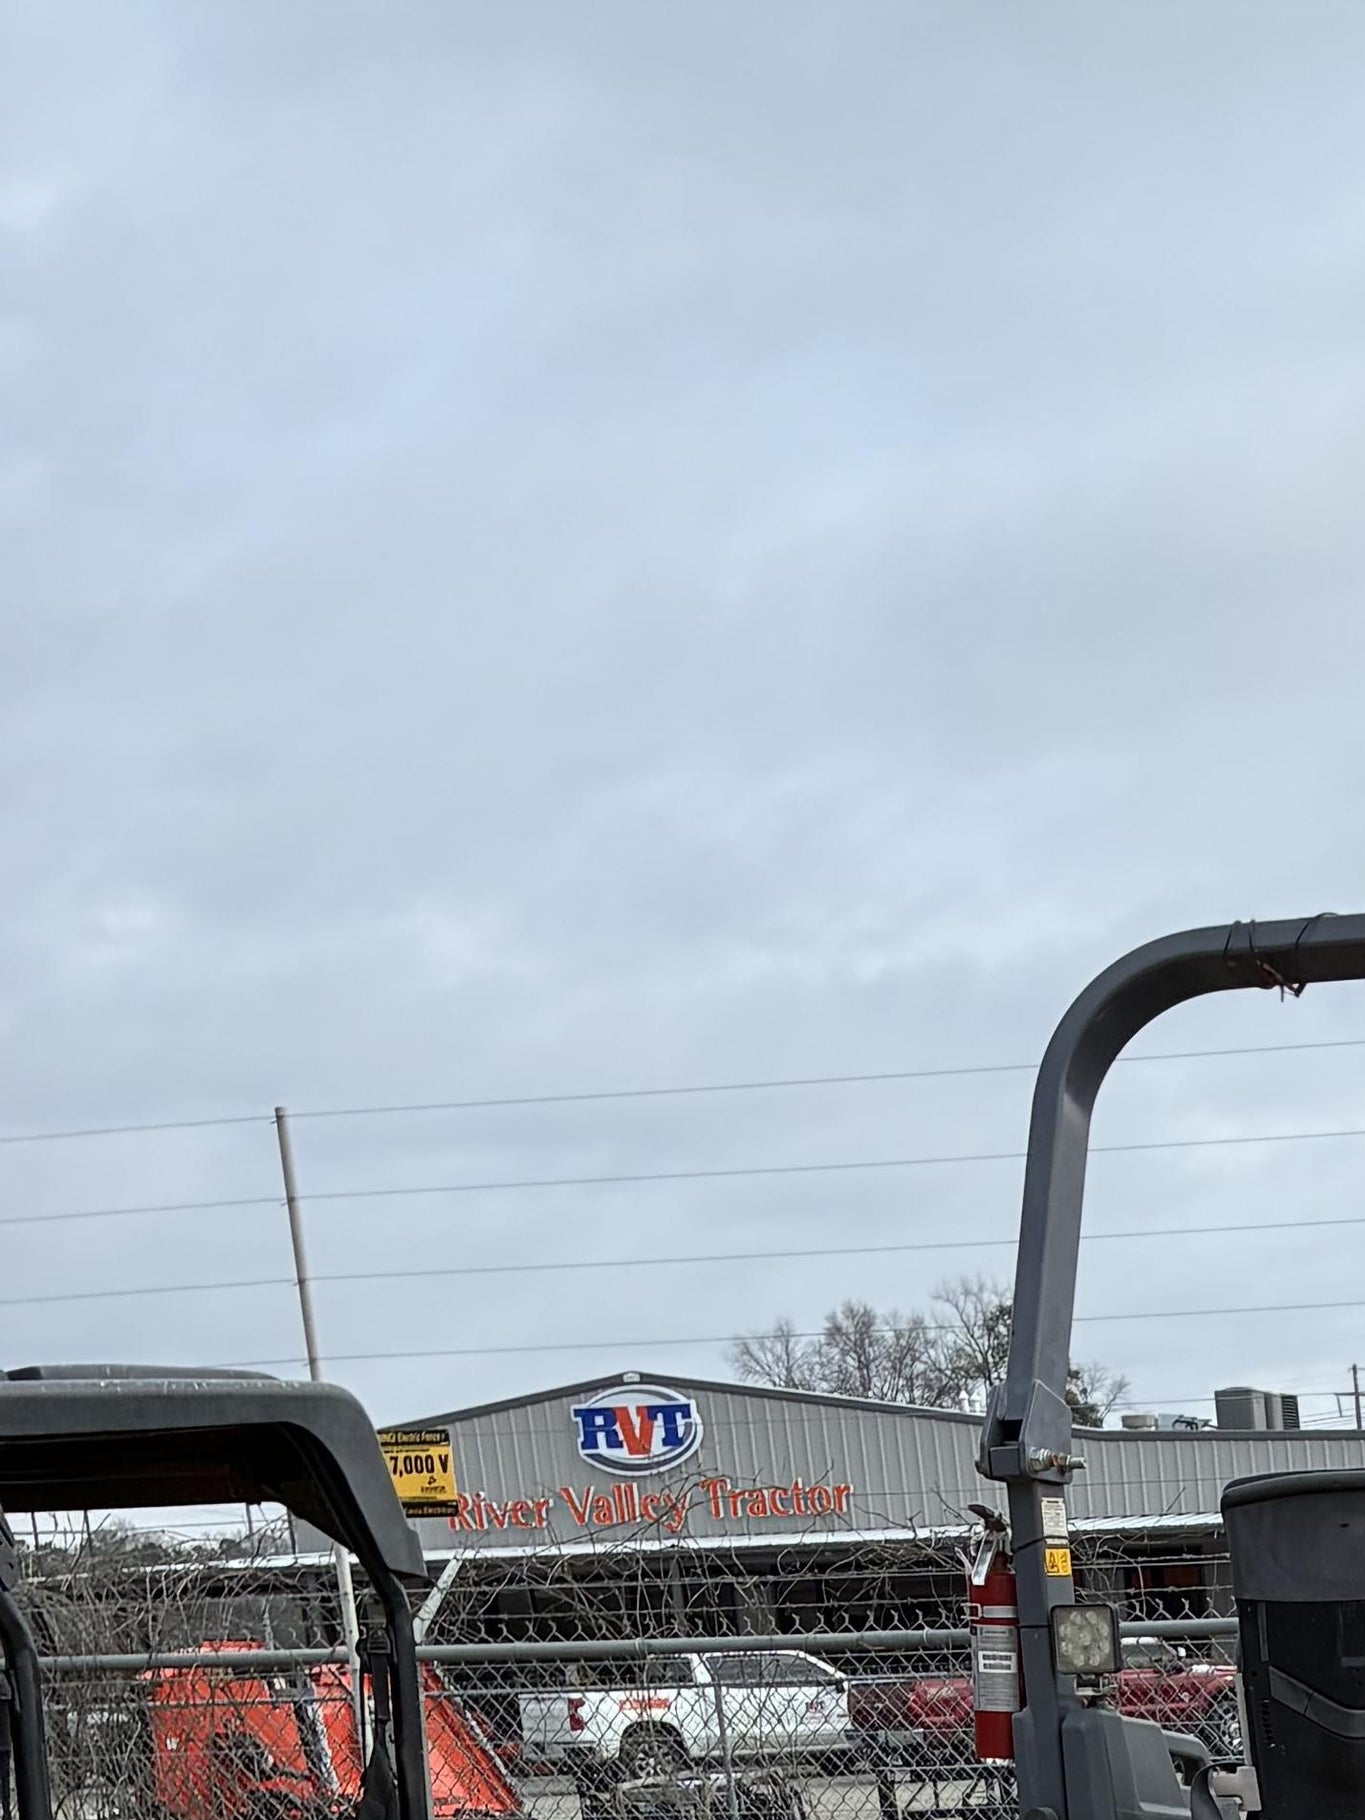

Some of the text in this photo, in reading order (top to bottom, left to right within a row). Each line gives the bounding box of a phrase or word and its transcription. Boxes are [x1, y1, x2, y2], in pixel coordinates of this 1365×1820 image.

[573, 1402, 693, 1456] RVT
[389, 1453, 449, 1478] 7,000 V
[446, 1478, 853, 1534] River Valley Tractor
